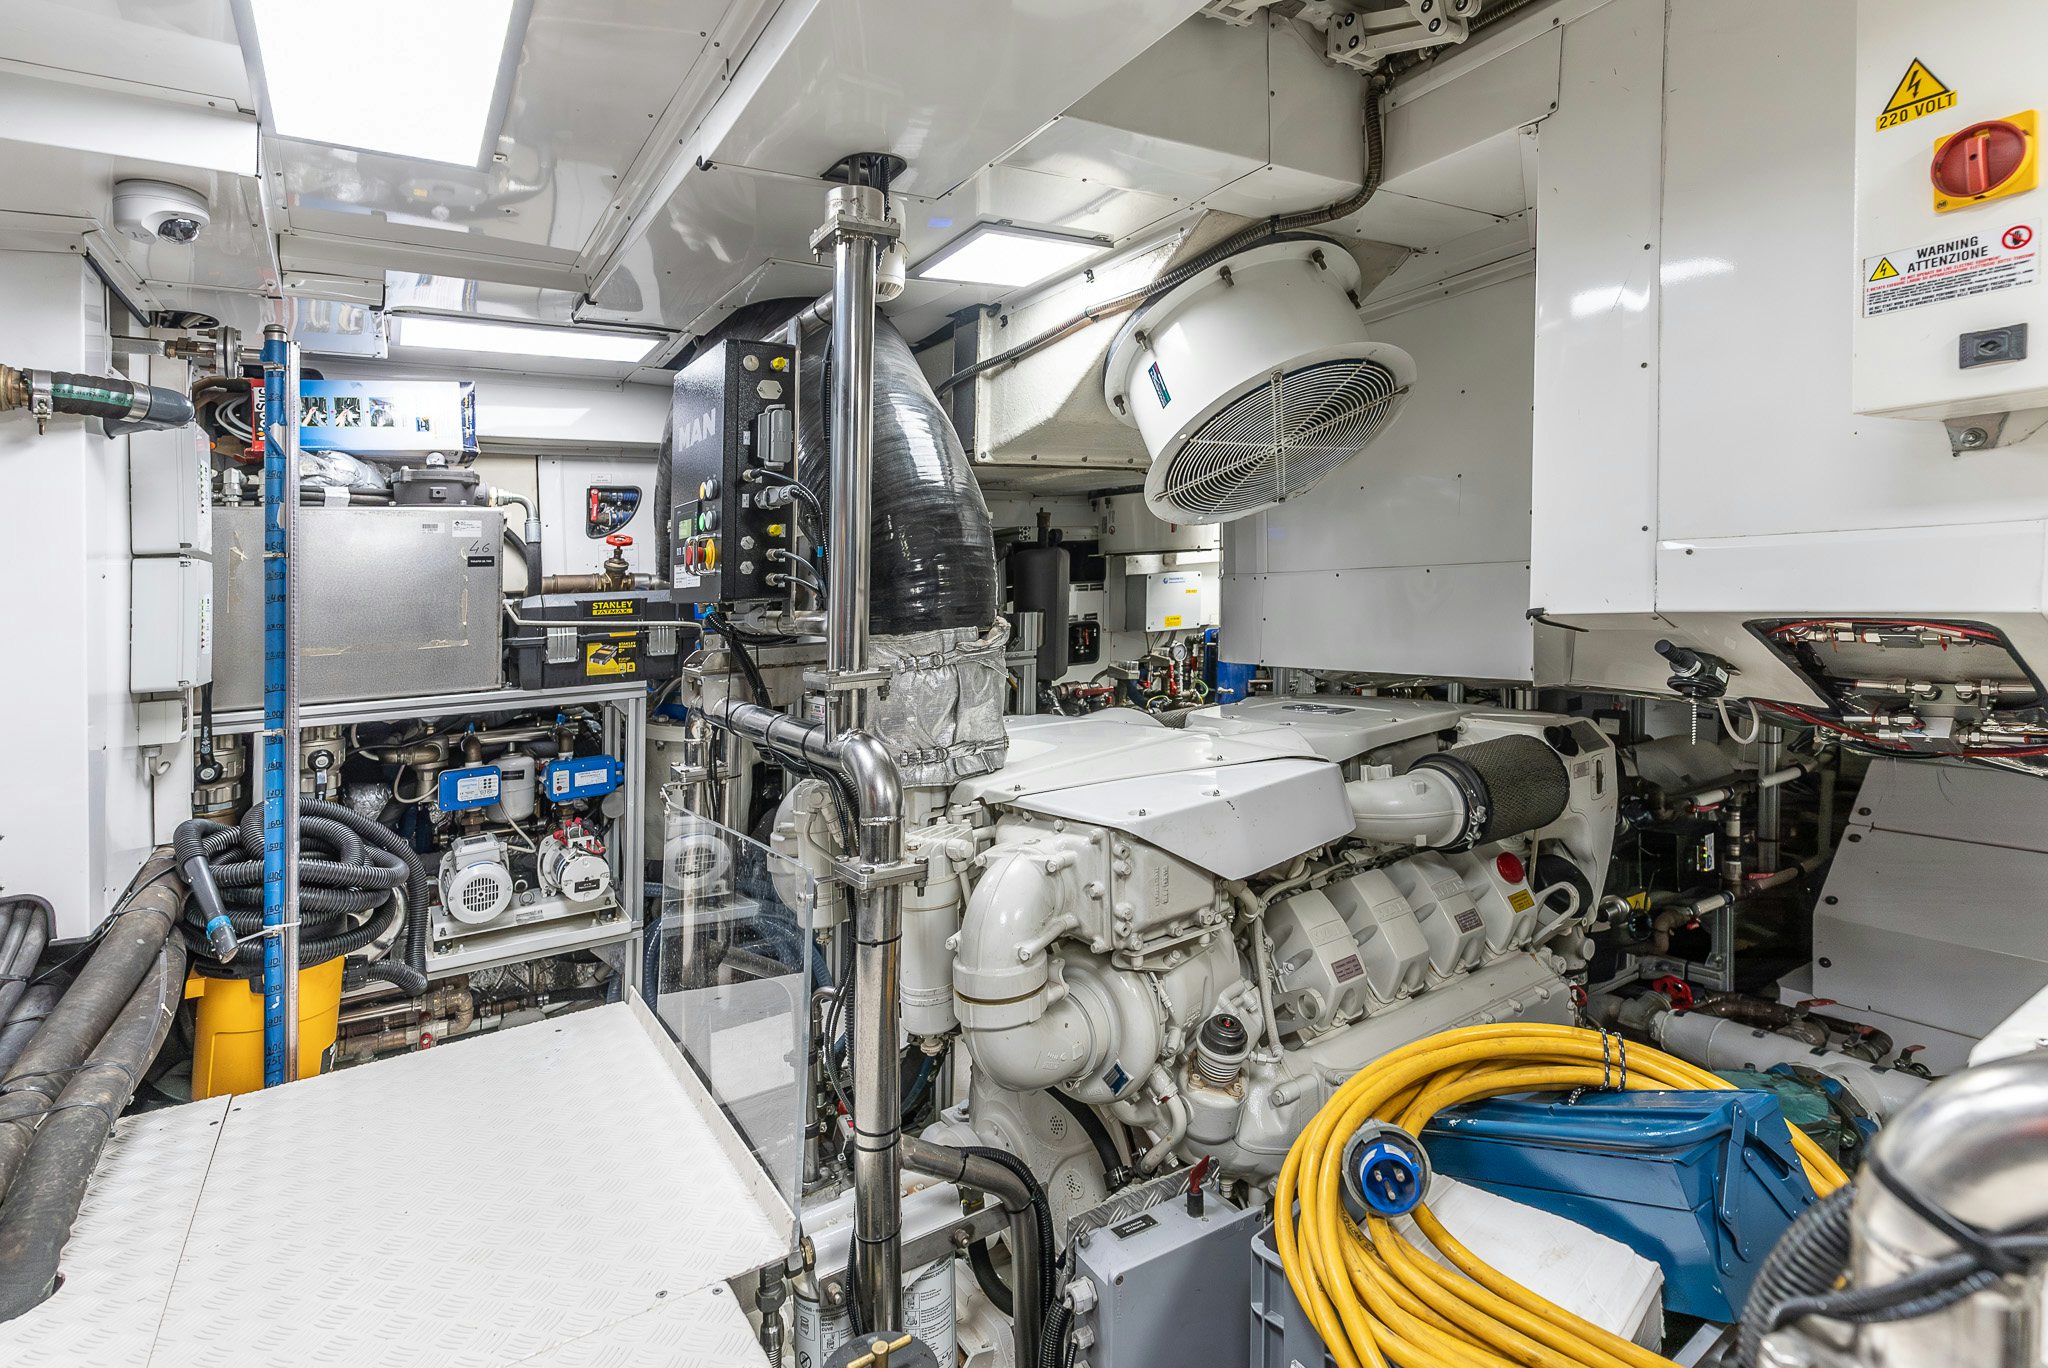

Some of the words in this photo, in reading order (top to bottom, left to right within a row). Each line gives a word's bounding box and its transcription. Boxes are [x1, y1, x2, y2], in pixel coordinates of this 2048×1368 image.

[1879, 109, 1908, 129] 220
[1914, 92, 1955, 117] VOLT
[1907, 245, 1989, 274] ATTENZIONE
[1917, 235, 1979, 259] WARNING
[678, 407, 717, 453] MAN
[592, 600, 633, 610] STANLEY
